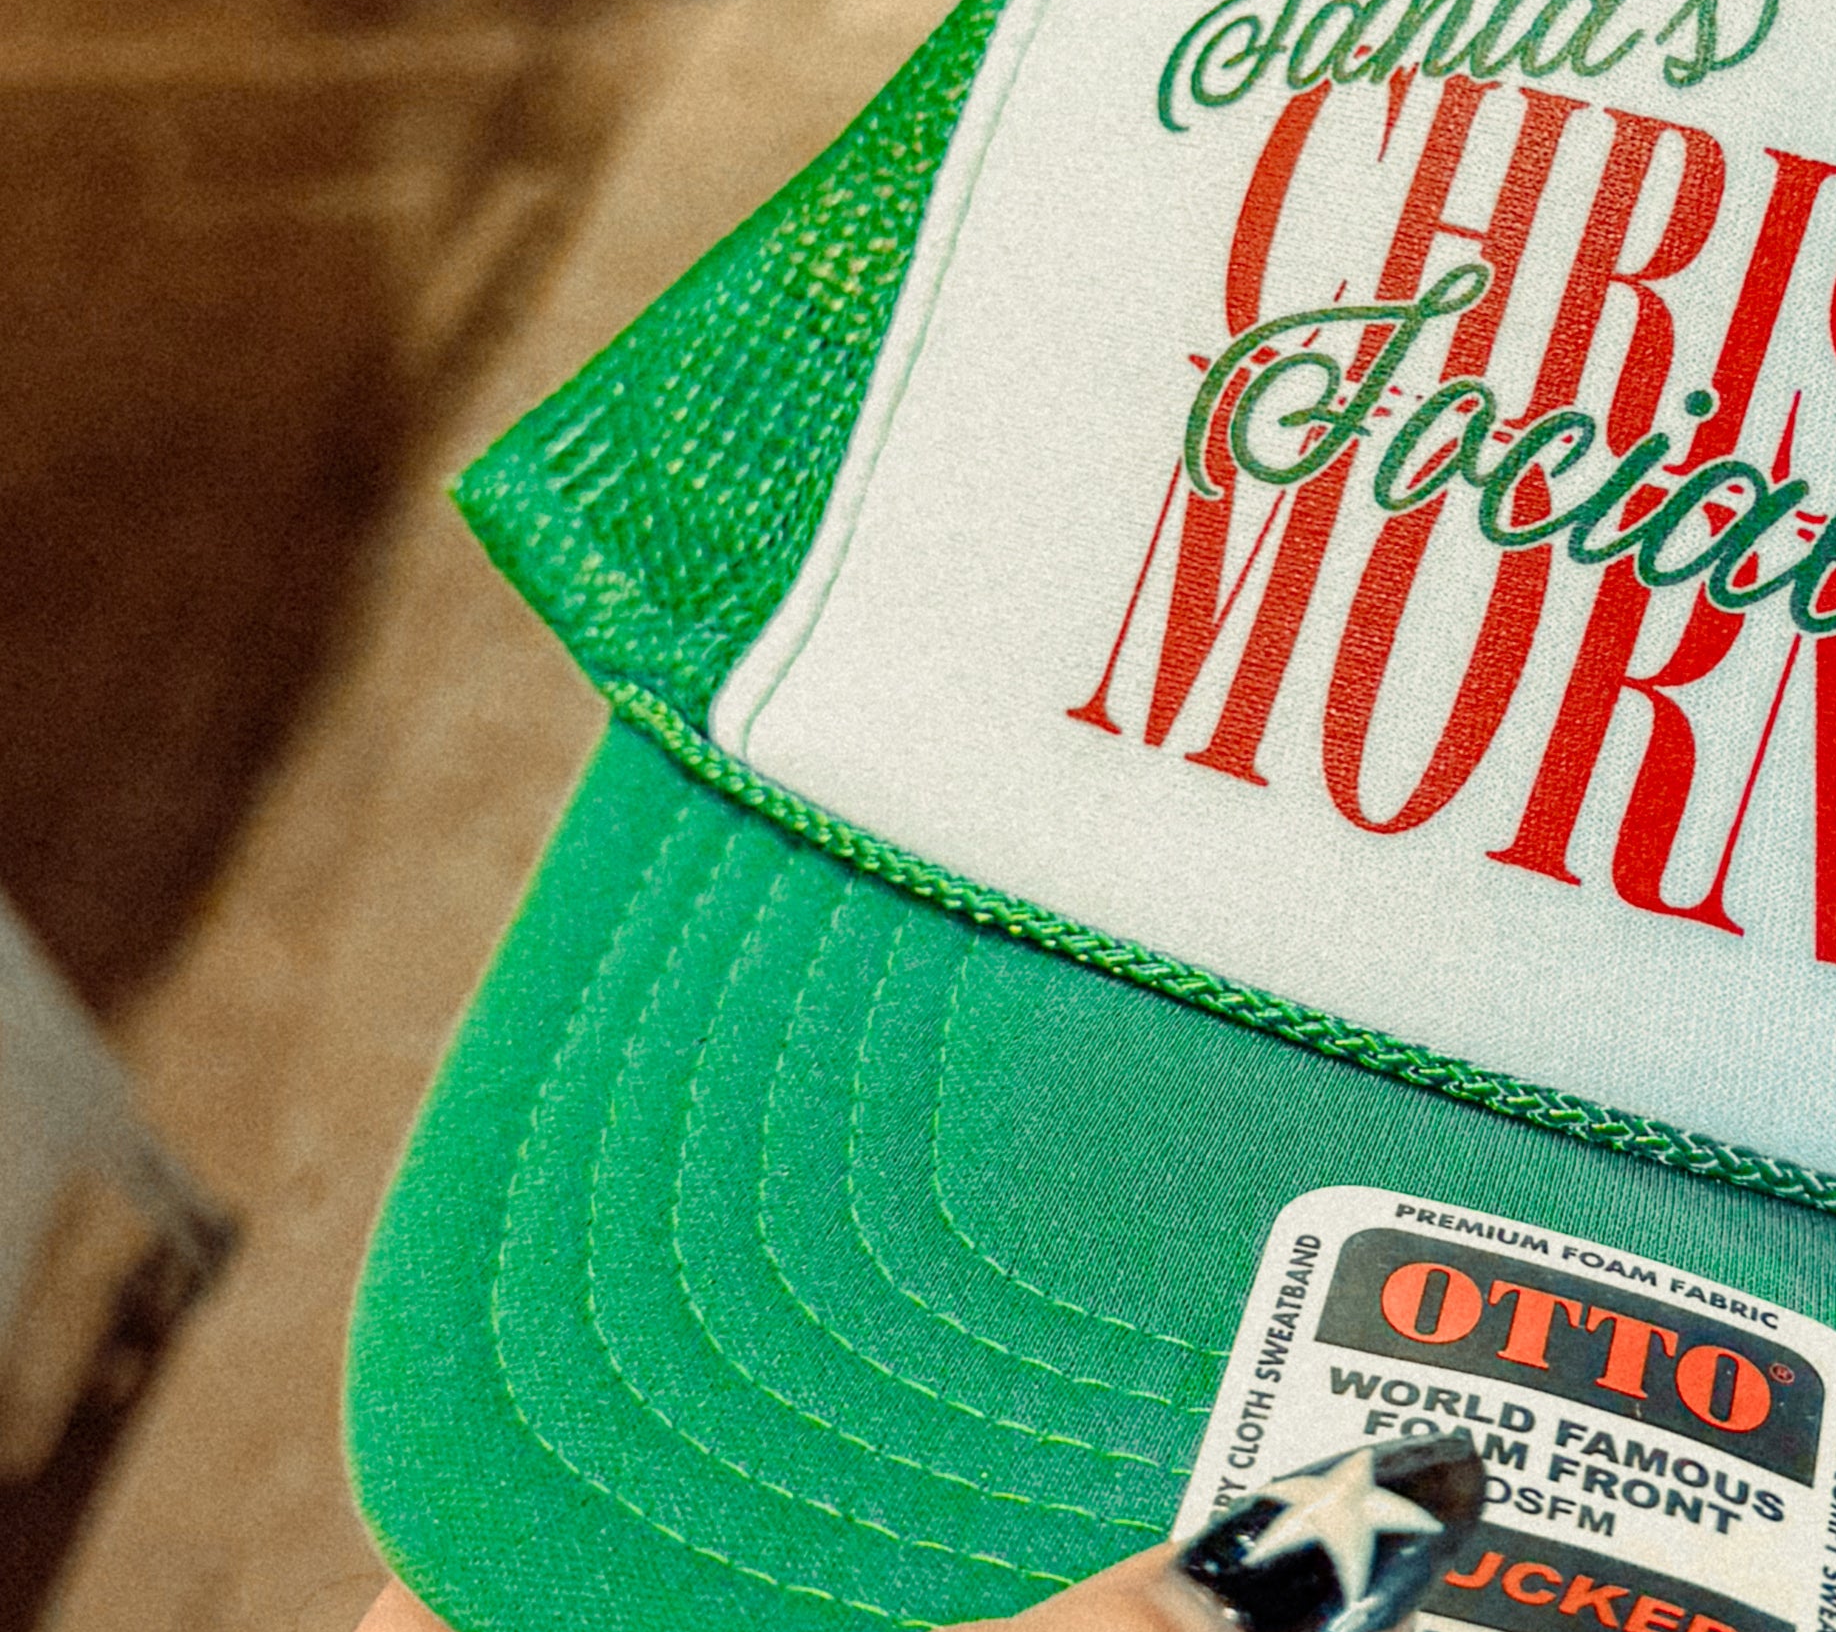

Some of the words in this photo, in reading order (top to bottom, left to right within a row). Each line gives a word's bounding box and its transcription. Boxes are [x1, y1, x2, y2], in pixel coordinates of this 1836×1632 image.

[1395, 1203, 1549, 1255] PREMIUM
[1562, 1244, 1658, 1288] FOAM
[1669, 1279, 1780, 1330] FABRIC
[1227, 1388, 1275, 1469] CLOTH
[1255, 1233, 1322, 1383] SWEATBAND
[1329, 1365, 1536, 1432] WORLD
[1554, 1417, 1785, 1522] FAMOUS
[1547, 1454, 1744, 1536] FRONT
